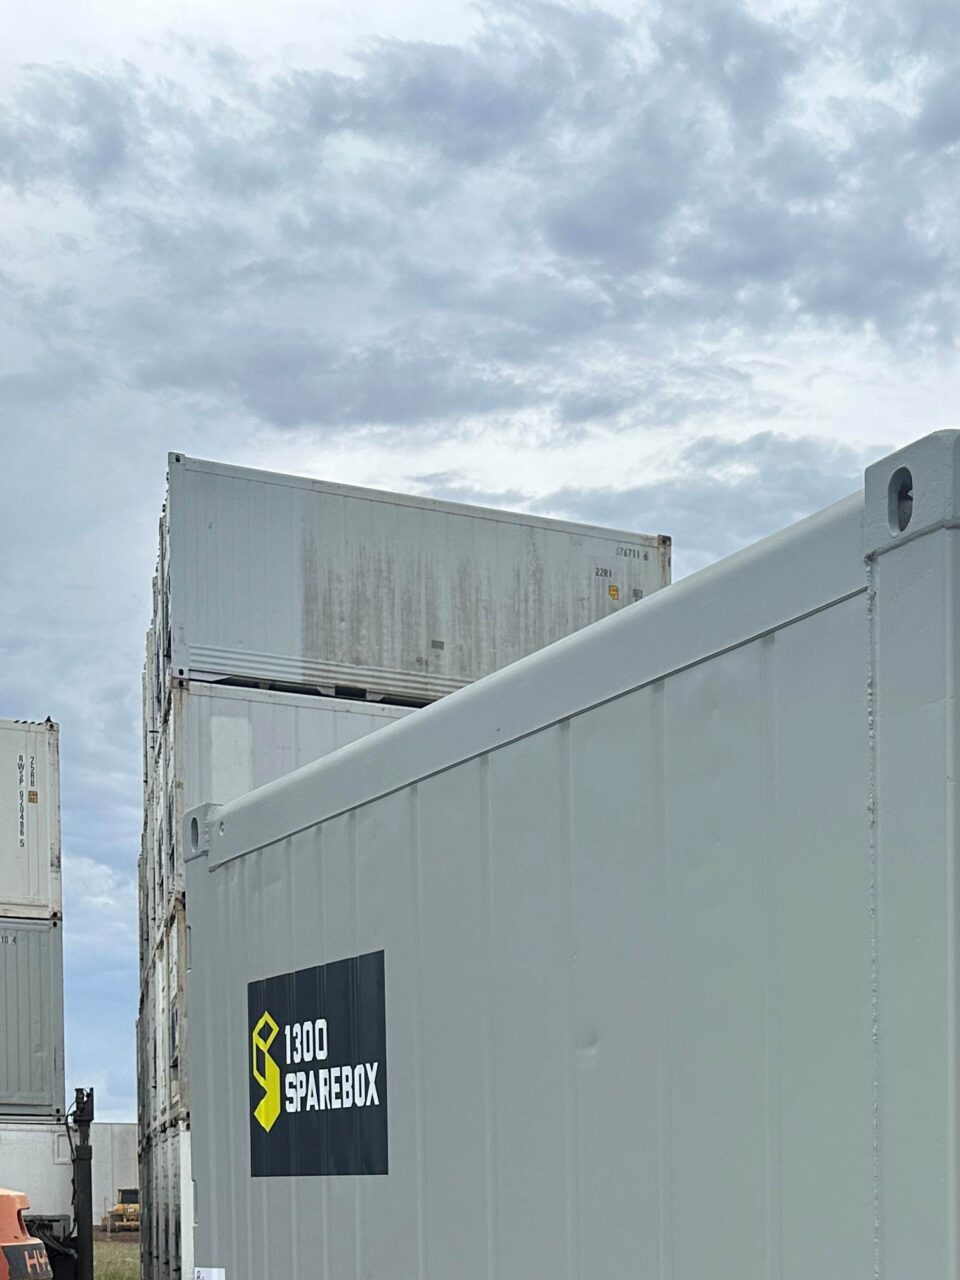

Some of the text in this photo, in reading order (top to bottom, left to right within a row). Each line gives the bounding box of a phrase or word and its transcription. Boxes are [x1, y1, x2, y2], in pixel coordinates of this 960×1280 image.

[284, 1018, 328, 1065] 1300
[284, 1062, 380, 1113] SPAREBOX
[24, 1249, 51, 1274] HY
